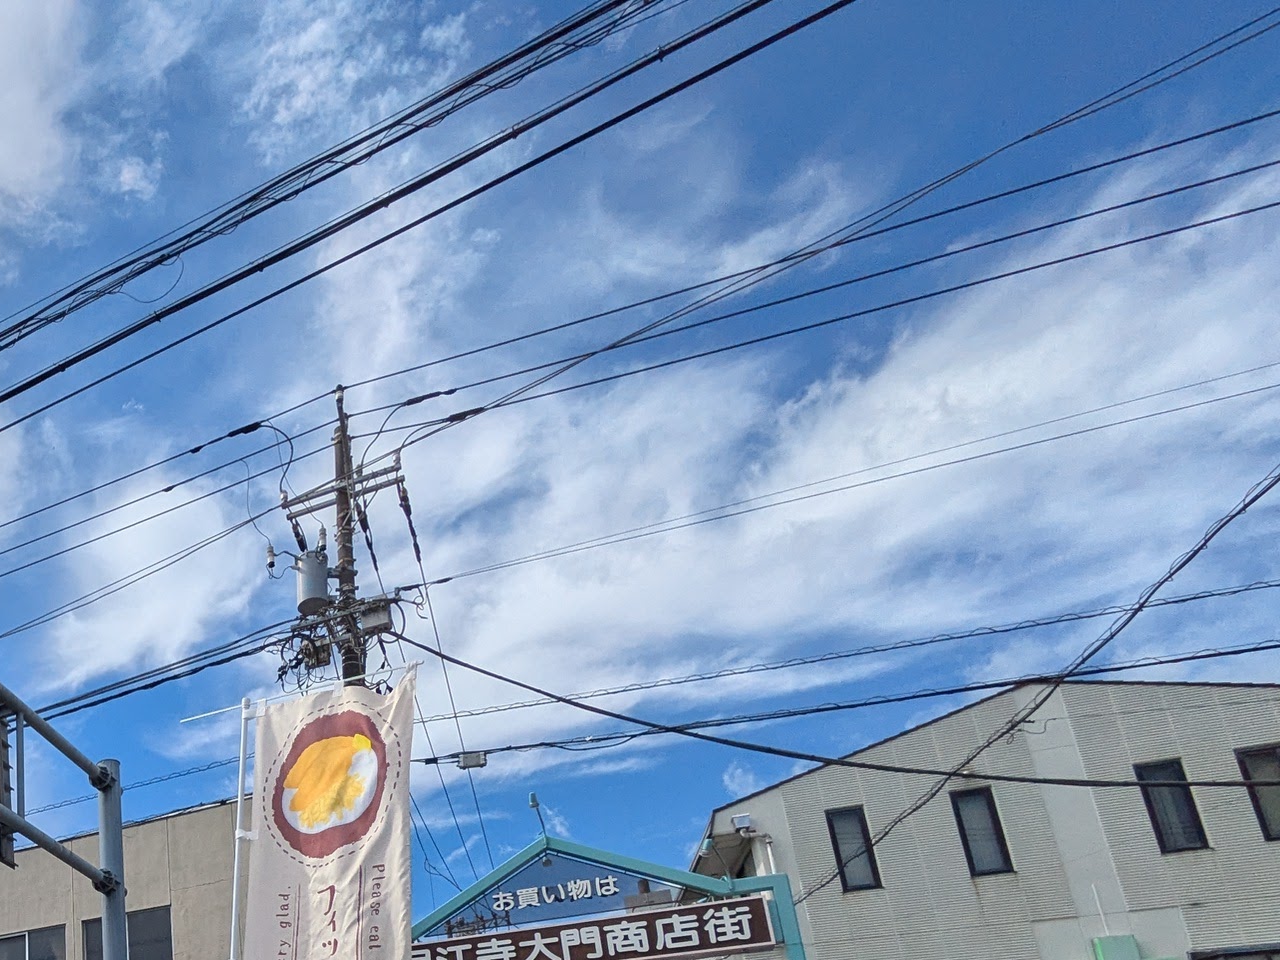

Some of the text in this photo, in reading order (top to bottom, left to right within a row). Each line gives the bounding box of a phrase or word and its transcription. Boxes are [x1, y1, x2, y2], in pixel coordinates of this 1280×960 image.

[276, 885, 292, 929] glad.
[371, 863, 386, 916] Please
[491, 875, 620, 913] お買い物は
[370, 925, 381, 951] eat
